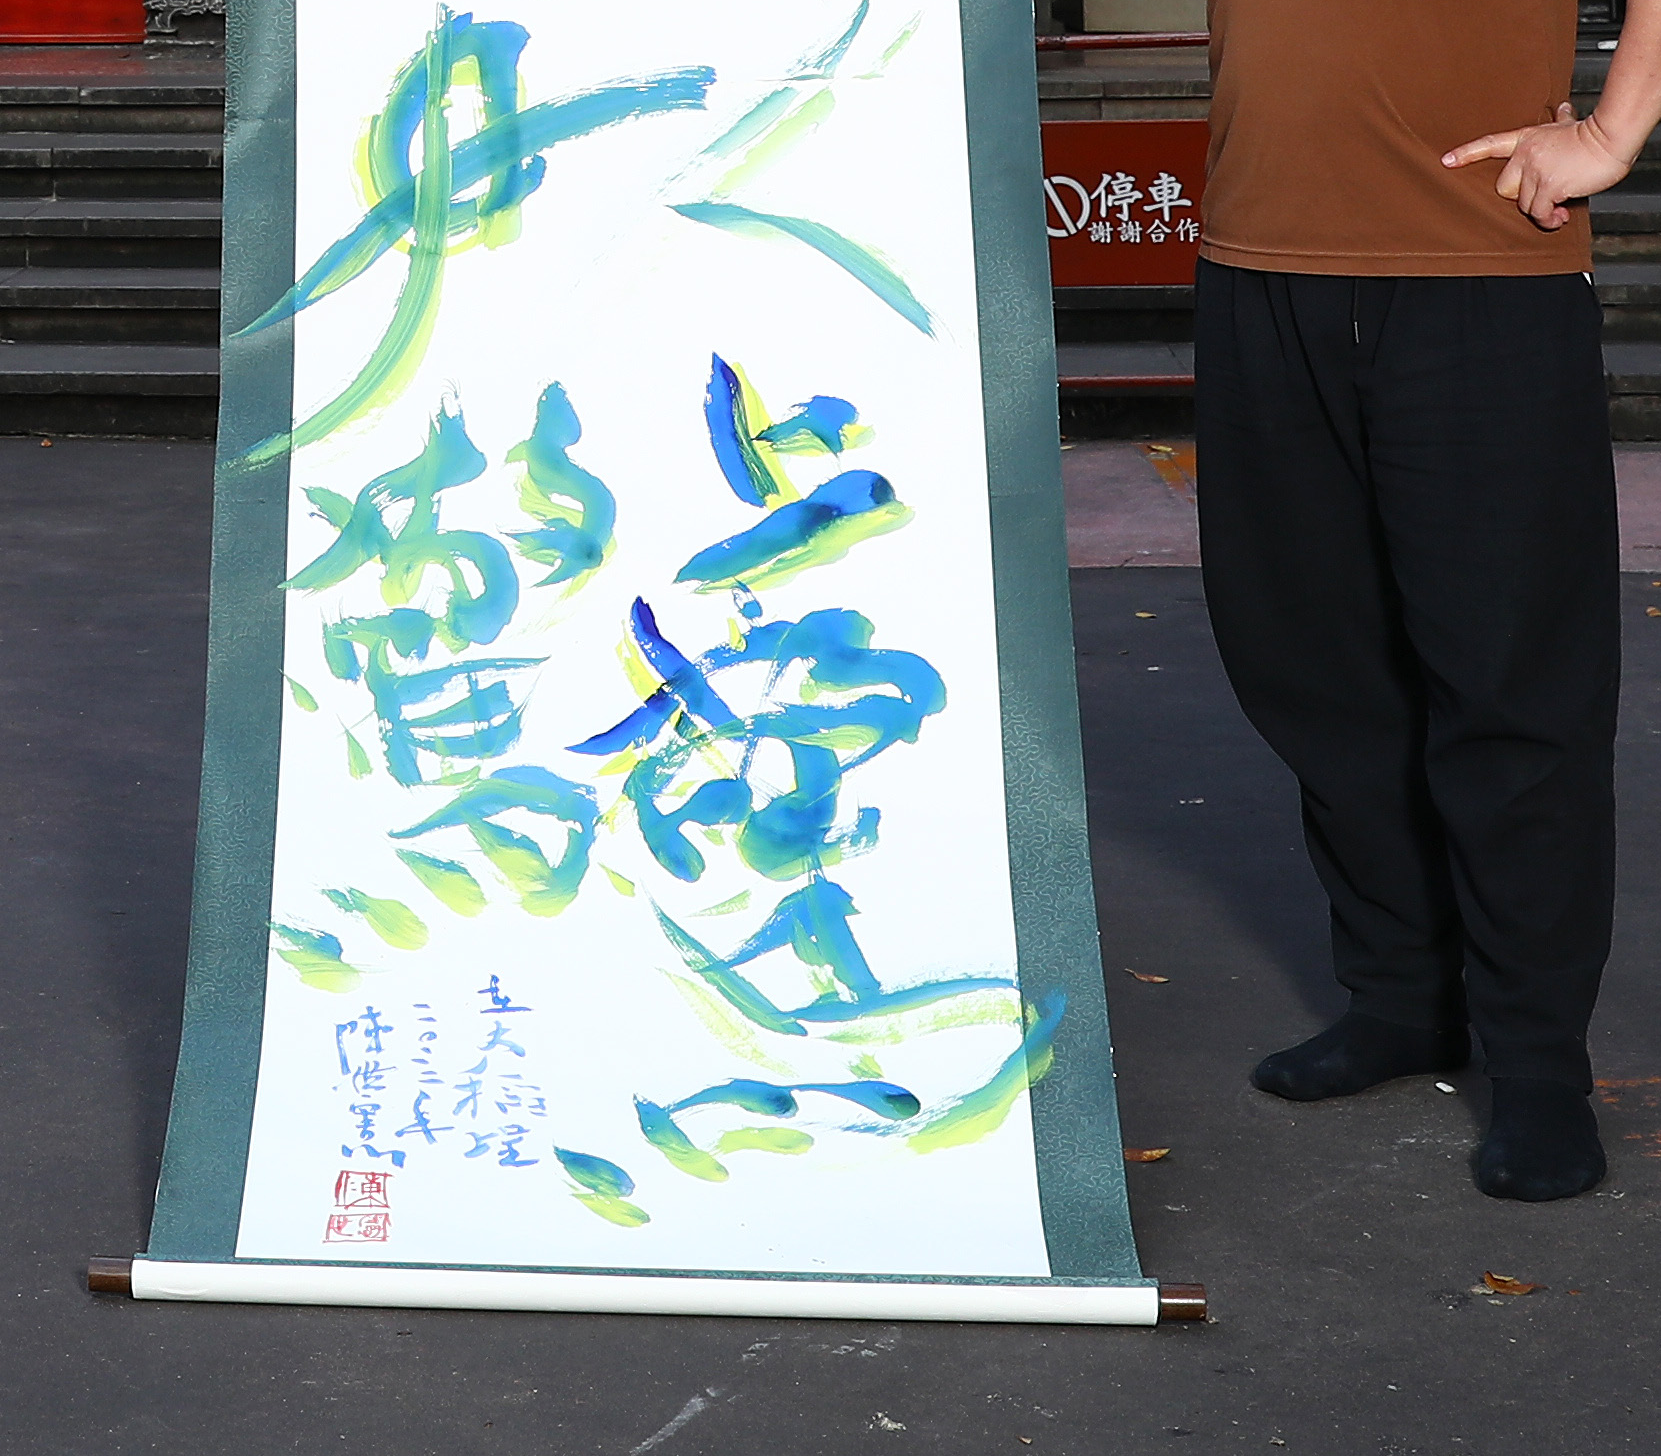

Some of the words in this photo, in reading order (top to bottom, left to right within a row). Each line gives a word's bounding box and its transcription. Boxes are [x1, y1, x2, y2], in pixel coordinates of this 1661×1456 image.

[1090, 171, 1192, 223] 停車
[1087, 219, 1200, 244] 謝謝合作
